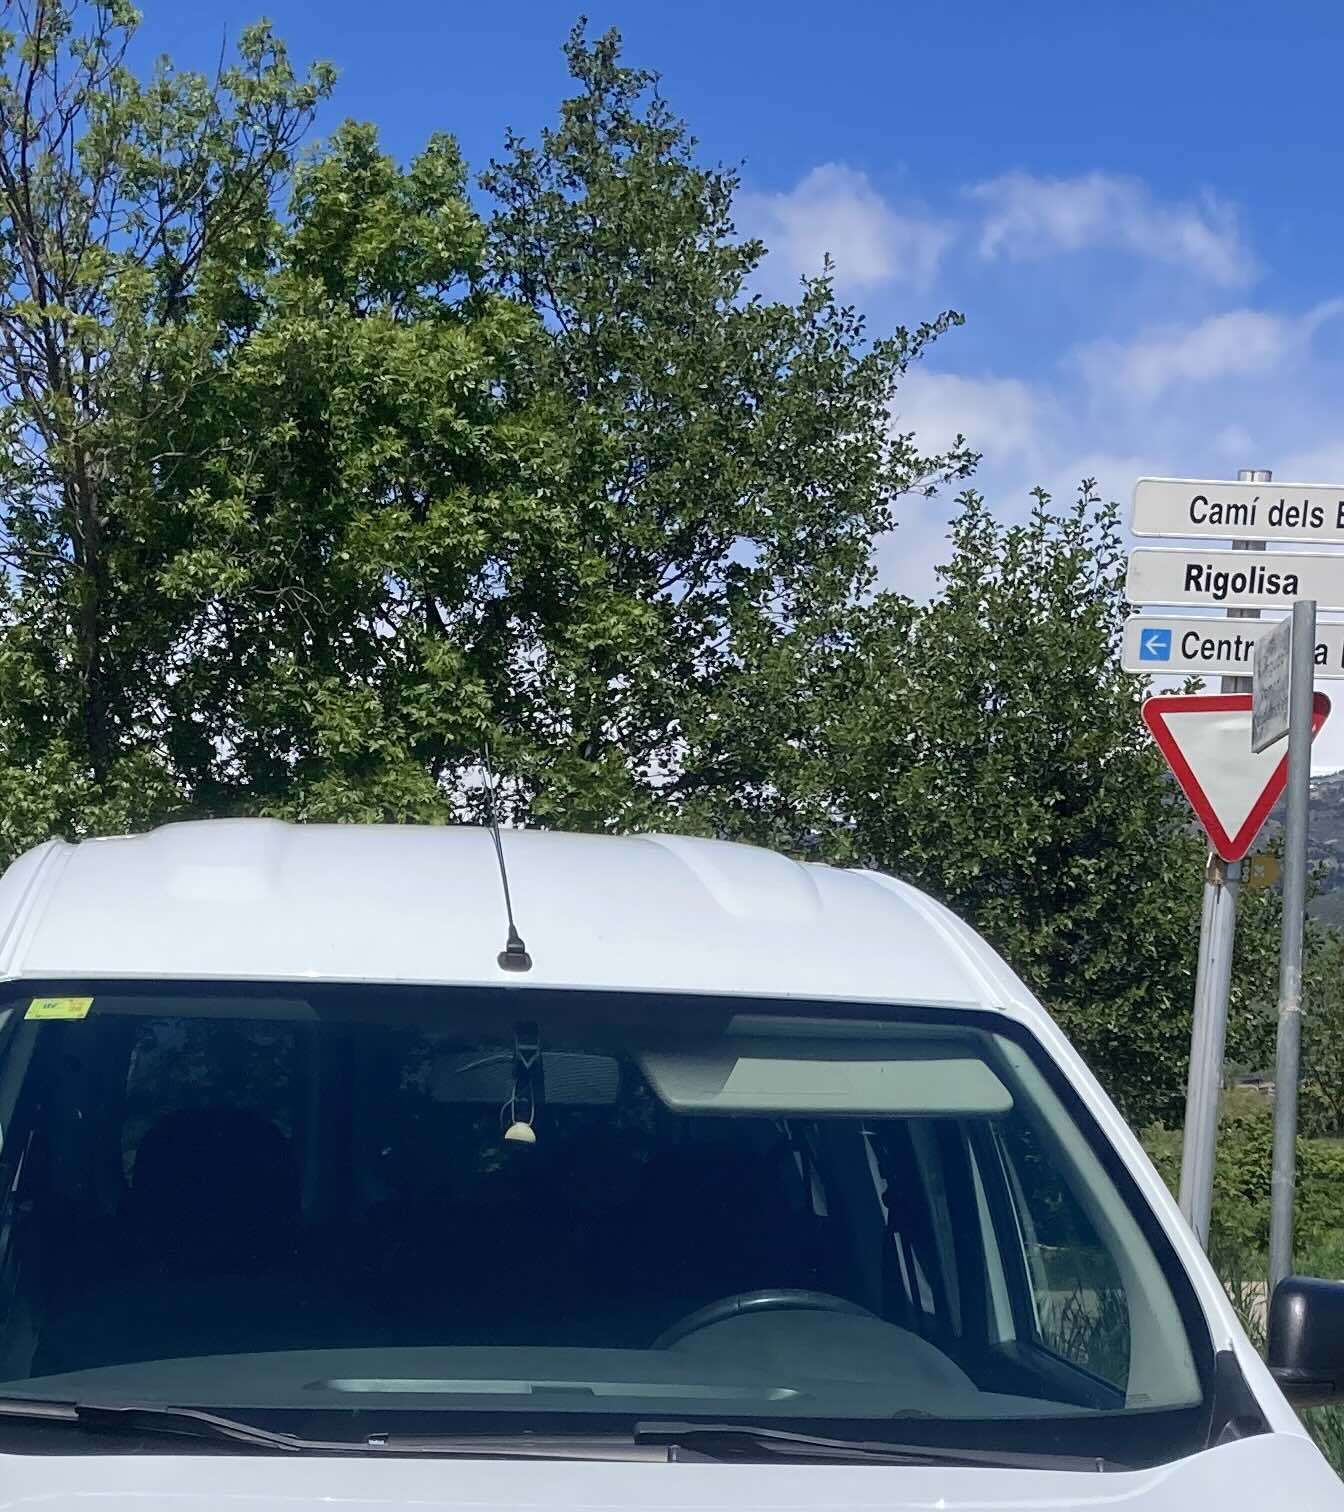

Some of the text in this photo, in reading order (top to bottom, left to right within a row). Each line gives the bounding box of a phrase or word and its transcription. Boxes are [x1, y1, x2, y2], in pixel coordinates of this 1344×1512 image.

[1189, 495, 1258, 526] Camí
[1268, 500, 1324, 528] dels
[1184, 563, 1299, 600] Rigolisa
[1181, 630, 1254, 662] Centr
